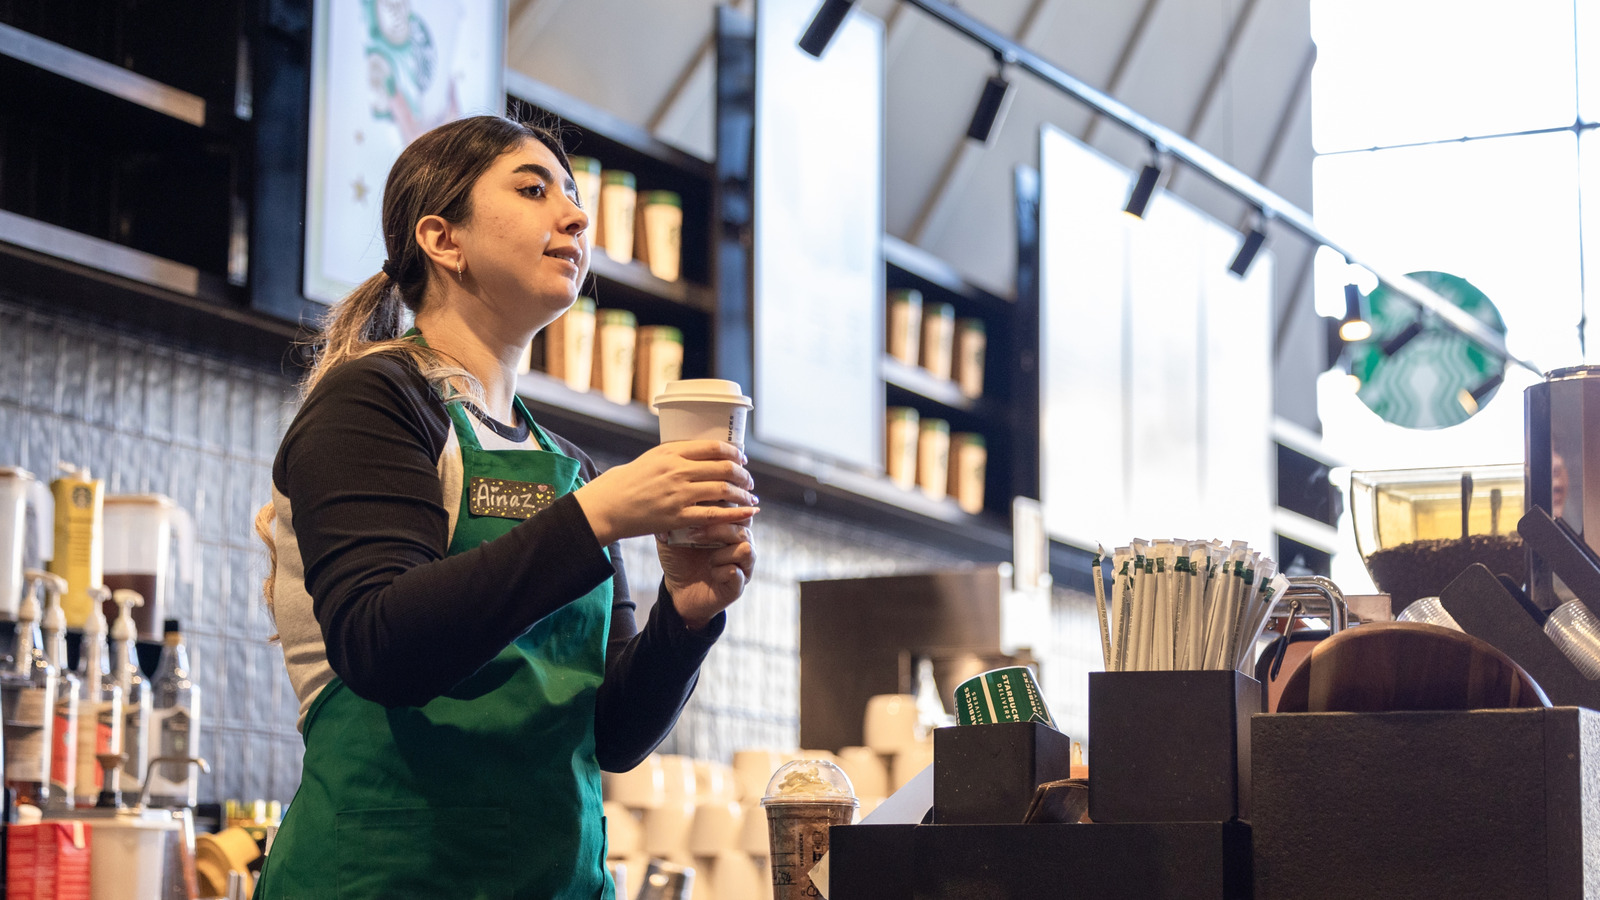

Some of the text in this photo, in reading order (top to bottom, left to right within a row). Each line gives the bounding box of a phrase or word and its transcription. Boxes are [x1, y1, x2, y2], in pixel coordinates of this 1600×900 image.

[477, 483, 536, 508] Ainaz
[964, 687, 977, 726] ARBUCKS
[997, 684, 1010, 719] DELIVERS
[1022, 672, 1038, 712] ARBUCKS
